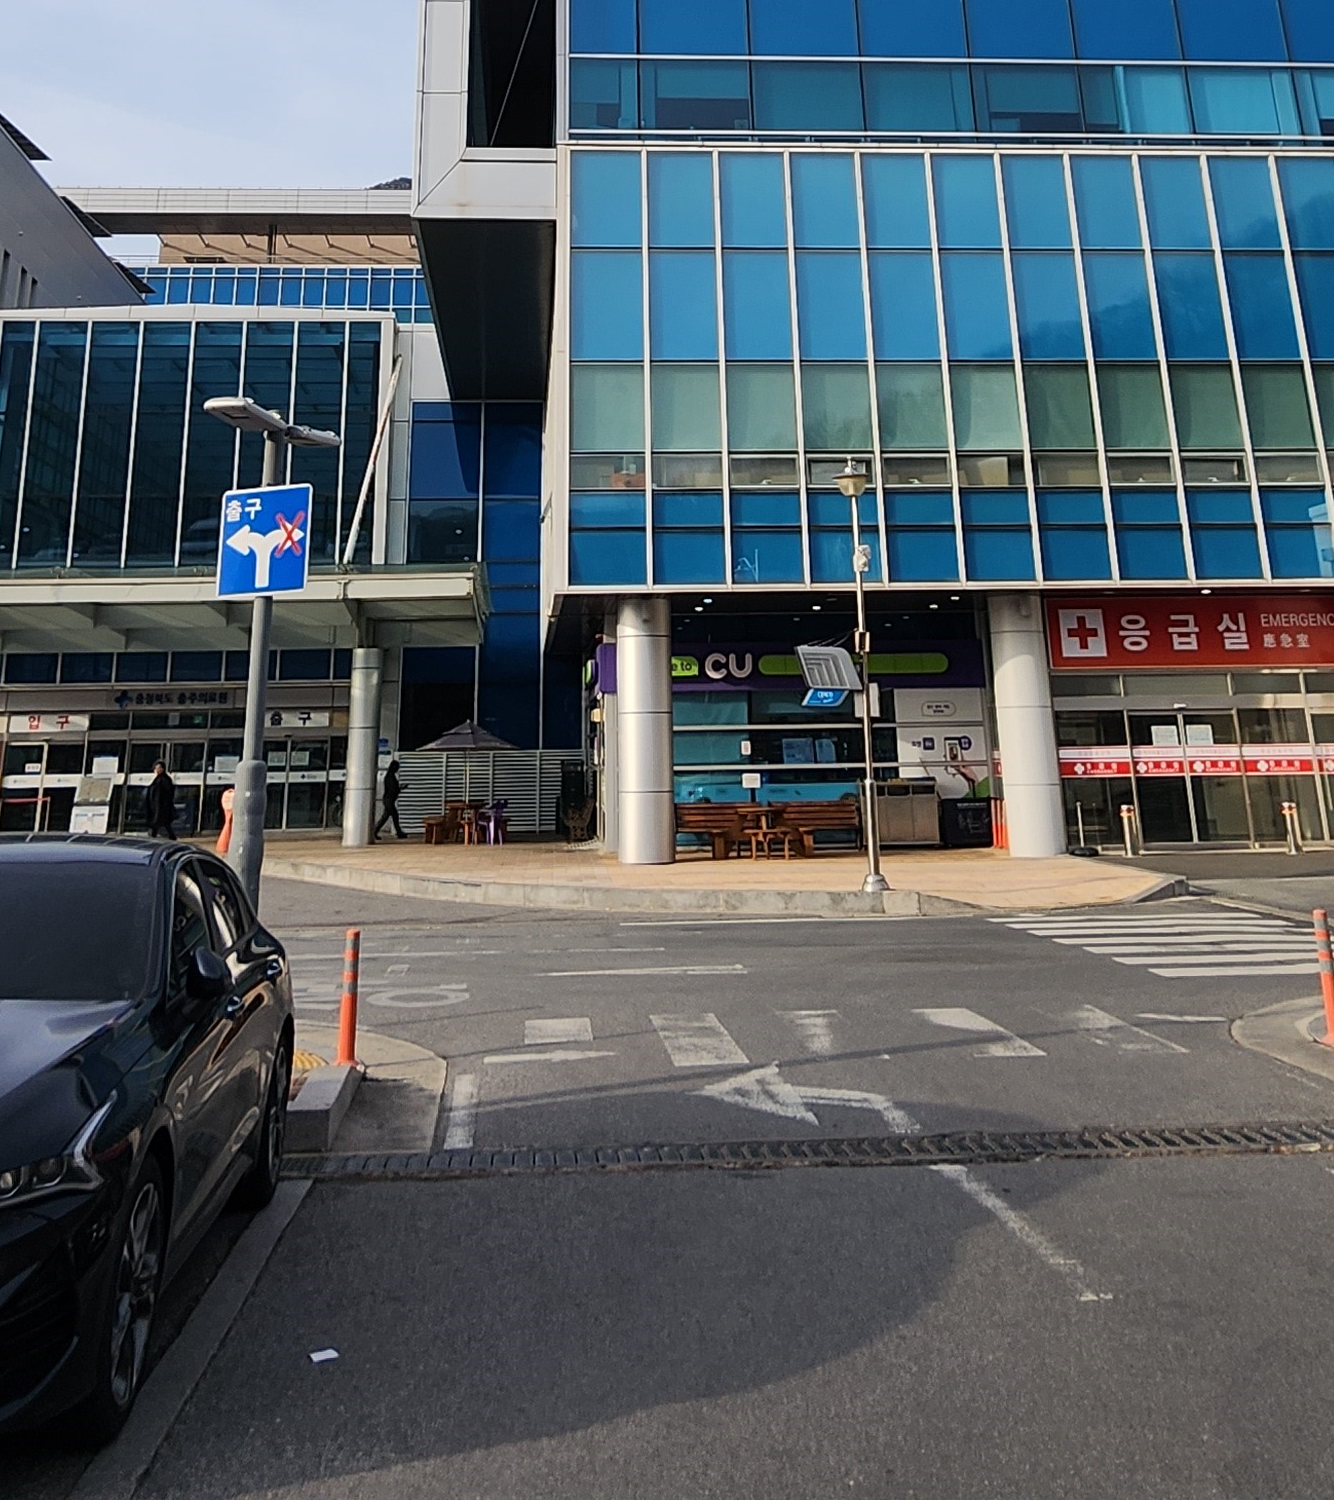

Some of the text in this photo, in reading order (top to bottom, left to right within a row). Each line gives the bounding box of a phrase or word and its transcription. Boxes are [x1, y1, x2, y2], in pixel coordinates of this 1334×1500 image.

[226, 498, 263, 523] 출구
[1118, 612, 1251, 652] 응급실
[680, 660, 693, 671] to
[705, 652, 753, 680] CU
